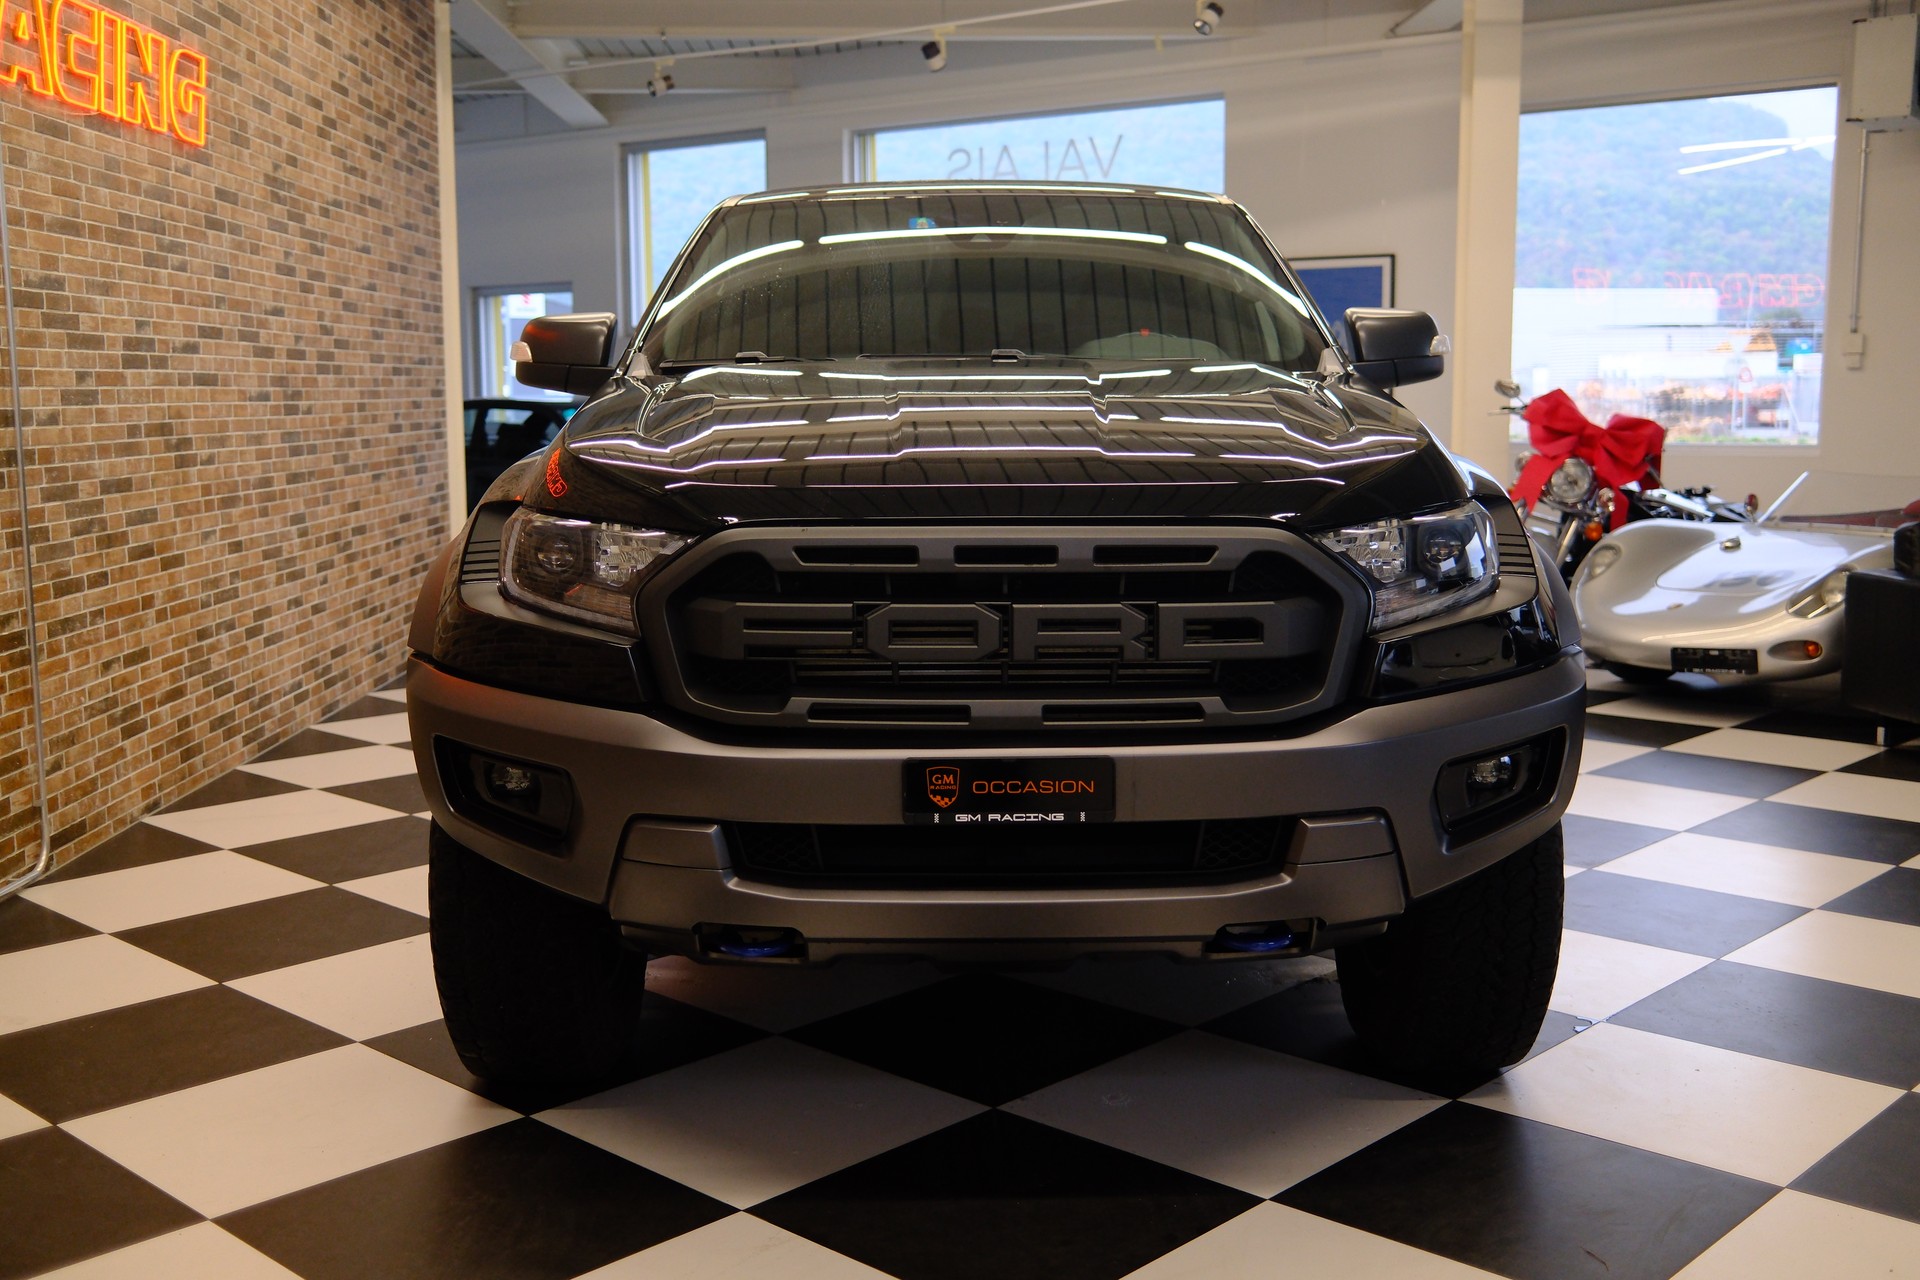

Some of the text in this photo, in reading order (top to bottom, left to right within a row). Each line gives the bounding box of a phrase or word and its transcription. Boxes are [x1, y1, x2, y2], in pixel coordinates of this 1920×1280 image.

[697, 601, 1308, 661] FORD
[932, 774, 954, 785] GM
[972, 780, 1095, 794] OCCASION
[955, 812, 1065, 822] GM RACING
